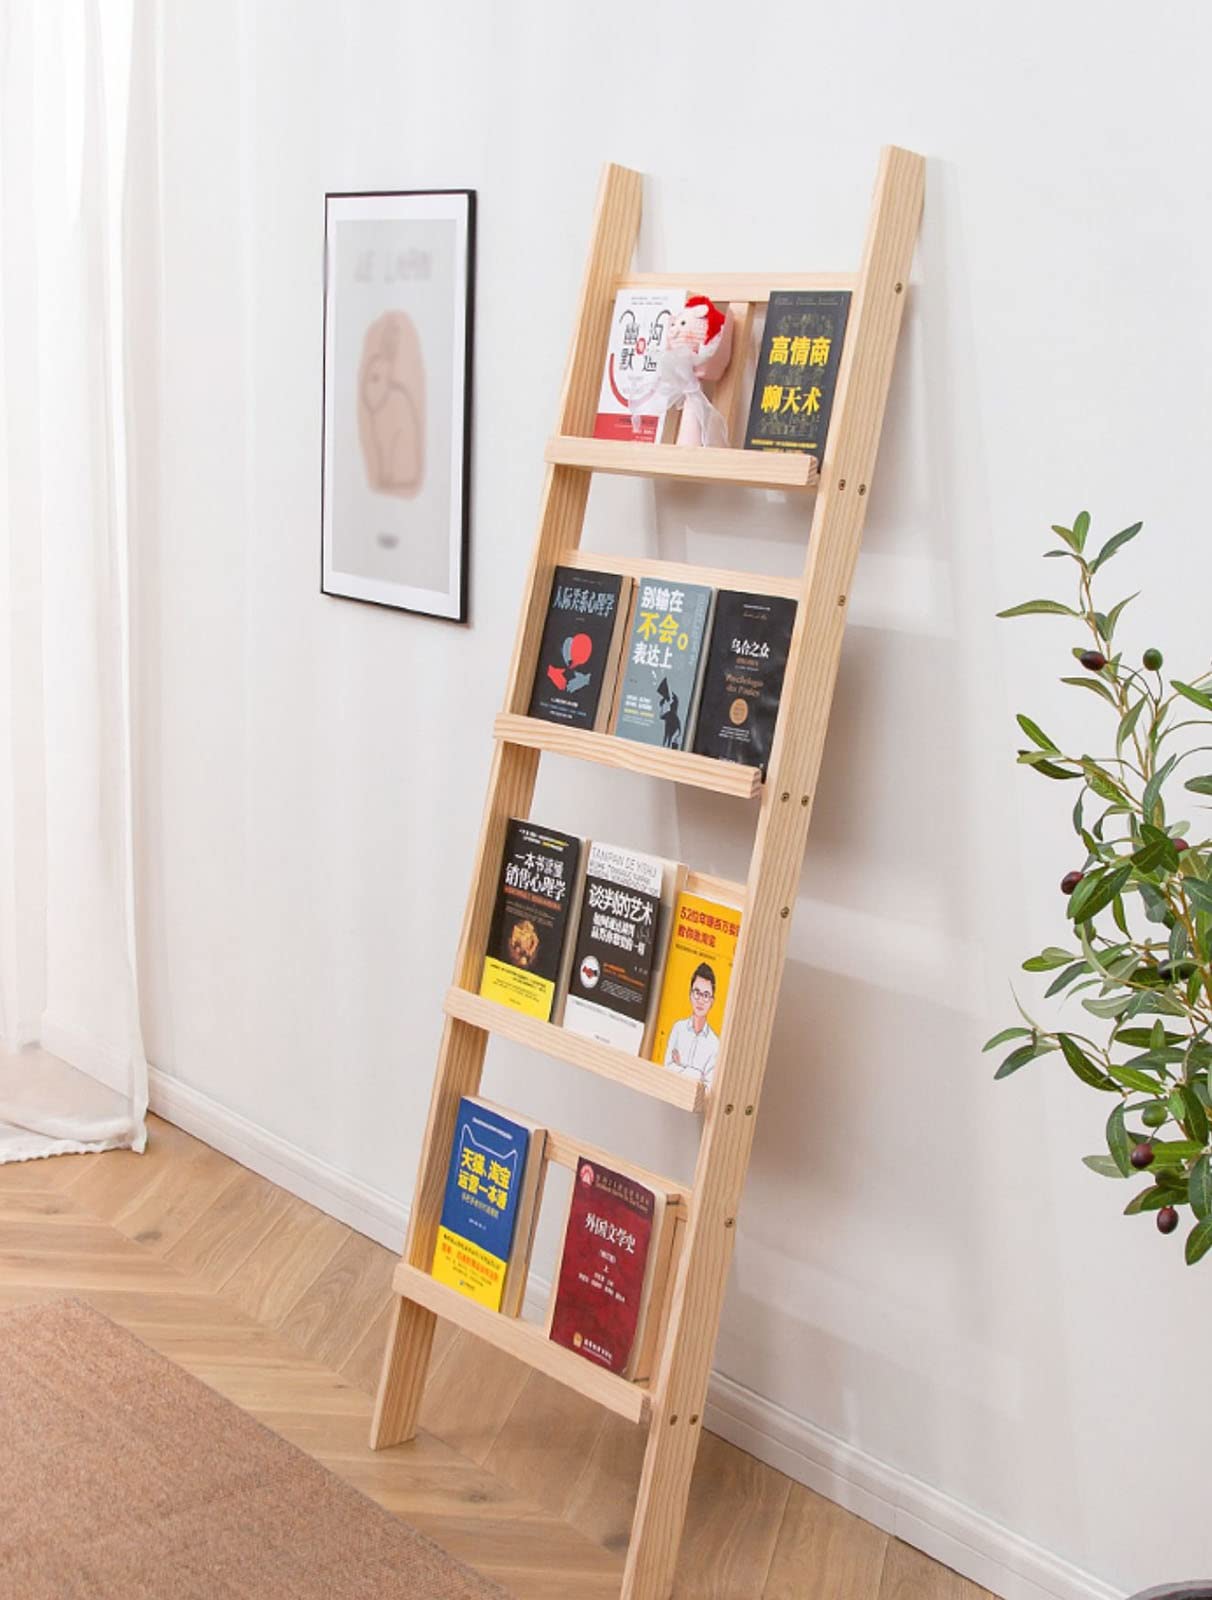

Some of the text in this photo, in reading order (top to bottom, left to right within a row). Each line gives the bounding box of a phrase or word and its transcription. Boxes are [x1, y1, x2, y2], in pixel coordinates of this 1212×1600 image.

[769, 336, 832, 366] 高情商
[760, 385, 822, 416] 聊天术
[640, 586, 685, 613] 别输在
[632, 641, 674, 669] 表达上
[731, 638, 770, 660] 乌合之众
[588, 883, 654, 926] 谈判的艺术
[457, 1168, 508, 1211] 运营一本通
[584, 1212, 637, 1254] 外国文学史
